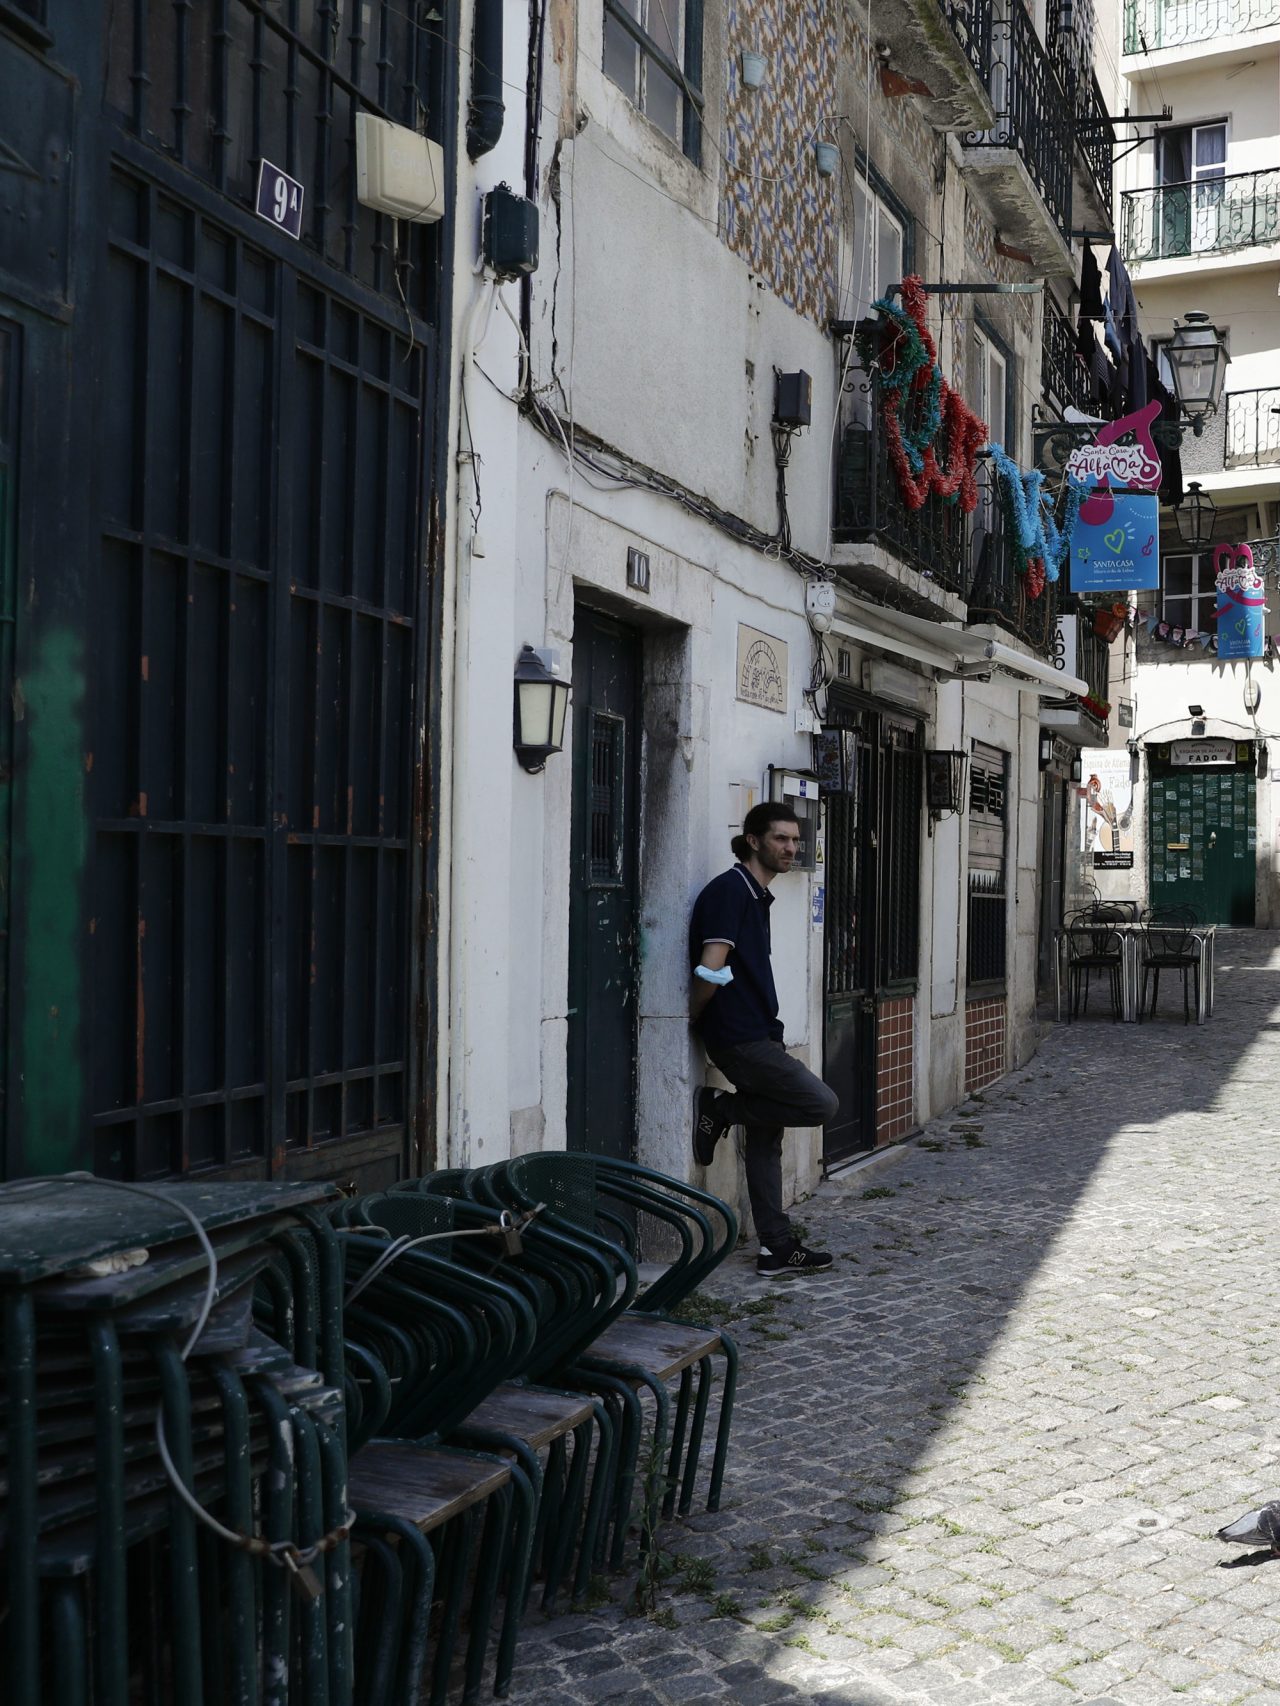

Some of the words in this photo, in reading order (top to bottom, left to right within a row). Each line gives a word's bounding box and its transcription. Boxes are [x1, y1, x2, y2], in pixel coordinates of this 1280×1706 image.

[633, 554, 646, 587] 10
[1093, 560, 1115, 568] SANTA
[1055, 615, 1066, 671] FADO
